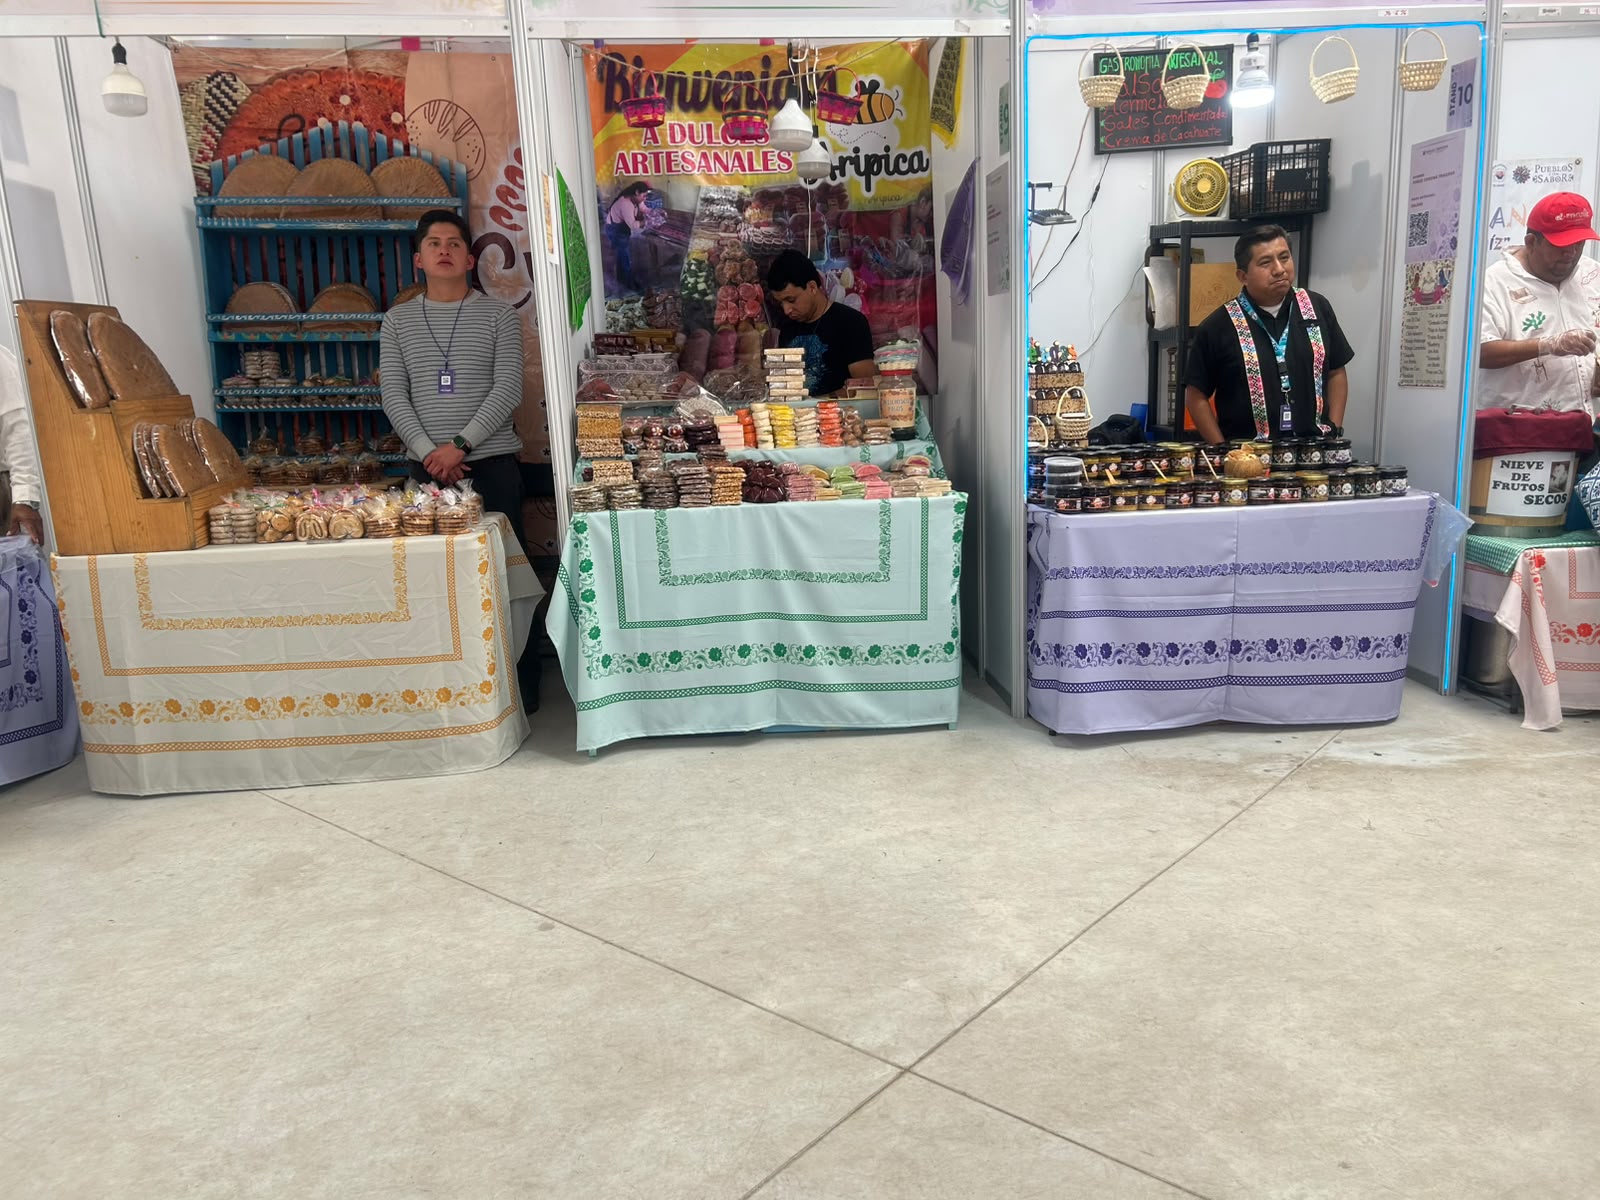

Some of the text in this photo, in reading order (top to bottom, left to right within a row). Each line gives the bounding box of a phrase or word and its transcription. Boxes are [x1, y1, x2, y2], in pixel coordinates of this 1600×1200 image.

[1099, 55, 1160, 74] GASRONOMIA
[1449, 82, 1458, 117] STAND
[1457, 83, 1473, 107] 10
[1104, 115, 1150, 132] Sales
[643, 127, 660, 145] A
[1104, 133, 1150, 148] Crema
[1154, 129, 1168, 143] de
[614, 151, 794, 176] ARTESANALES
[1534, 163, 1574, 174] PUEBLOS
[1537, 173, 1568, 184] SABOR
[1500, 460, 1544, 470] NIEVE
[1510, 473, 1531, 481] DE
[1492, 480, 1545, 492] FRUTOS
[1523, 493, 1568, 505] SECOS
